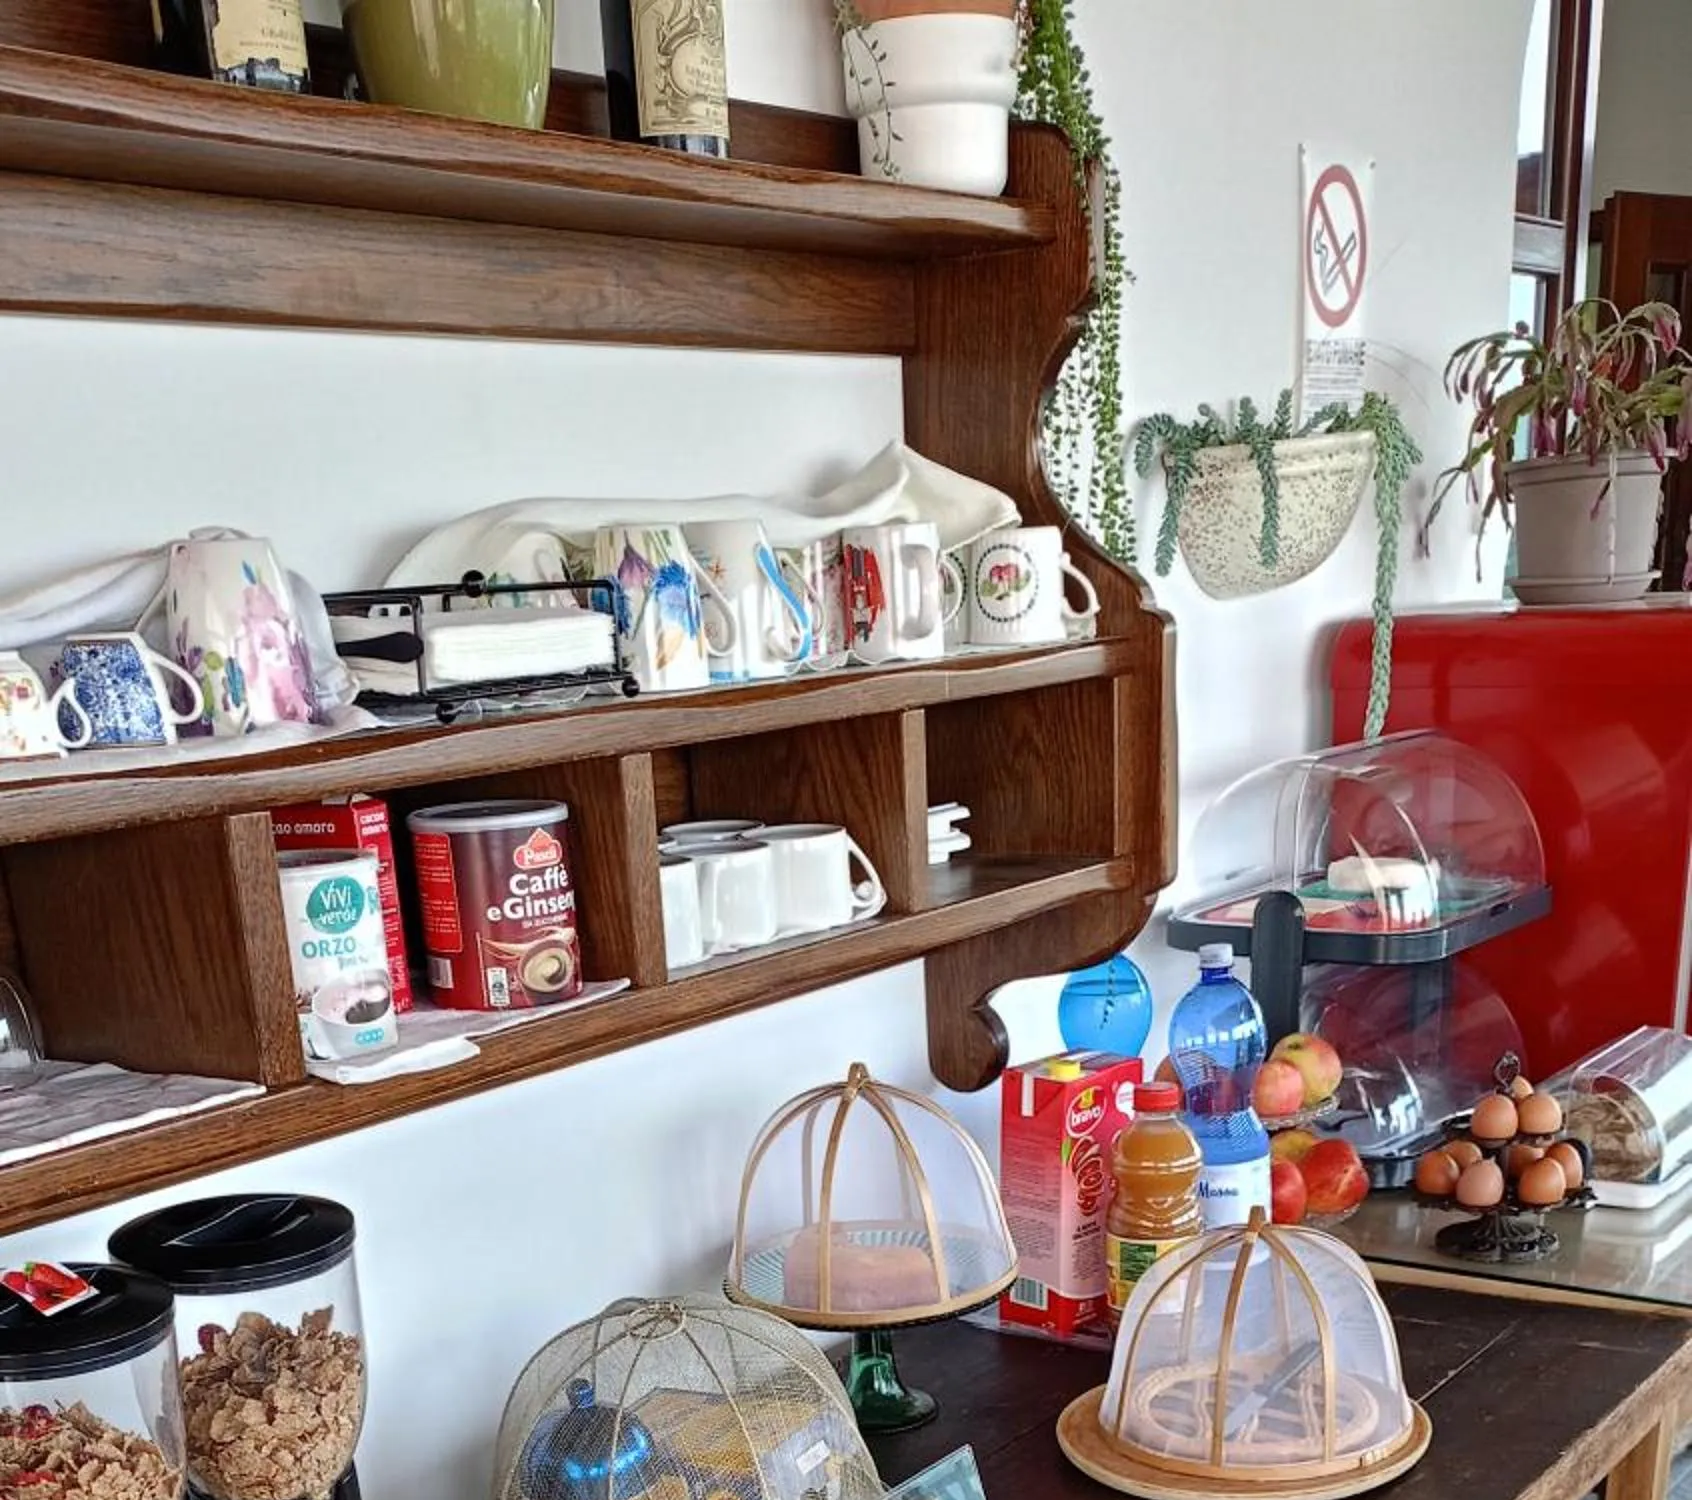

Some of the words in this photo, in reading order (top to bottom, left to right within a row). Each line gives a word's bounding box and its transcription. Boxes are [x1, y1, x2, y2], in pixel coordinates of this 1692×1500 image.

[294, 822, 335, 834] amaro
[509, 863, 569, 896] Caffè
[487, 906, 502, 921] e
[302, 936, 356, 958] ORZO
